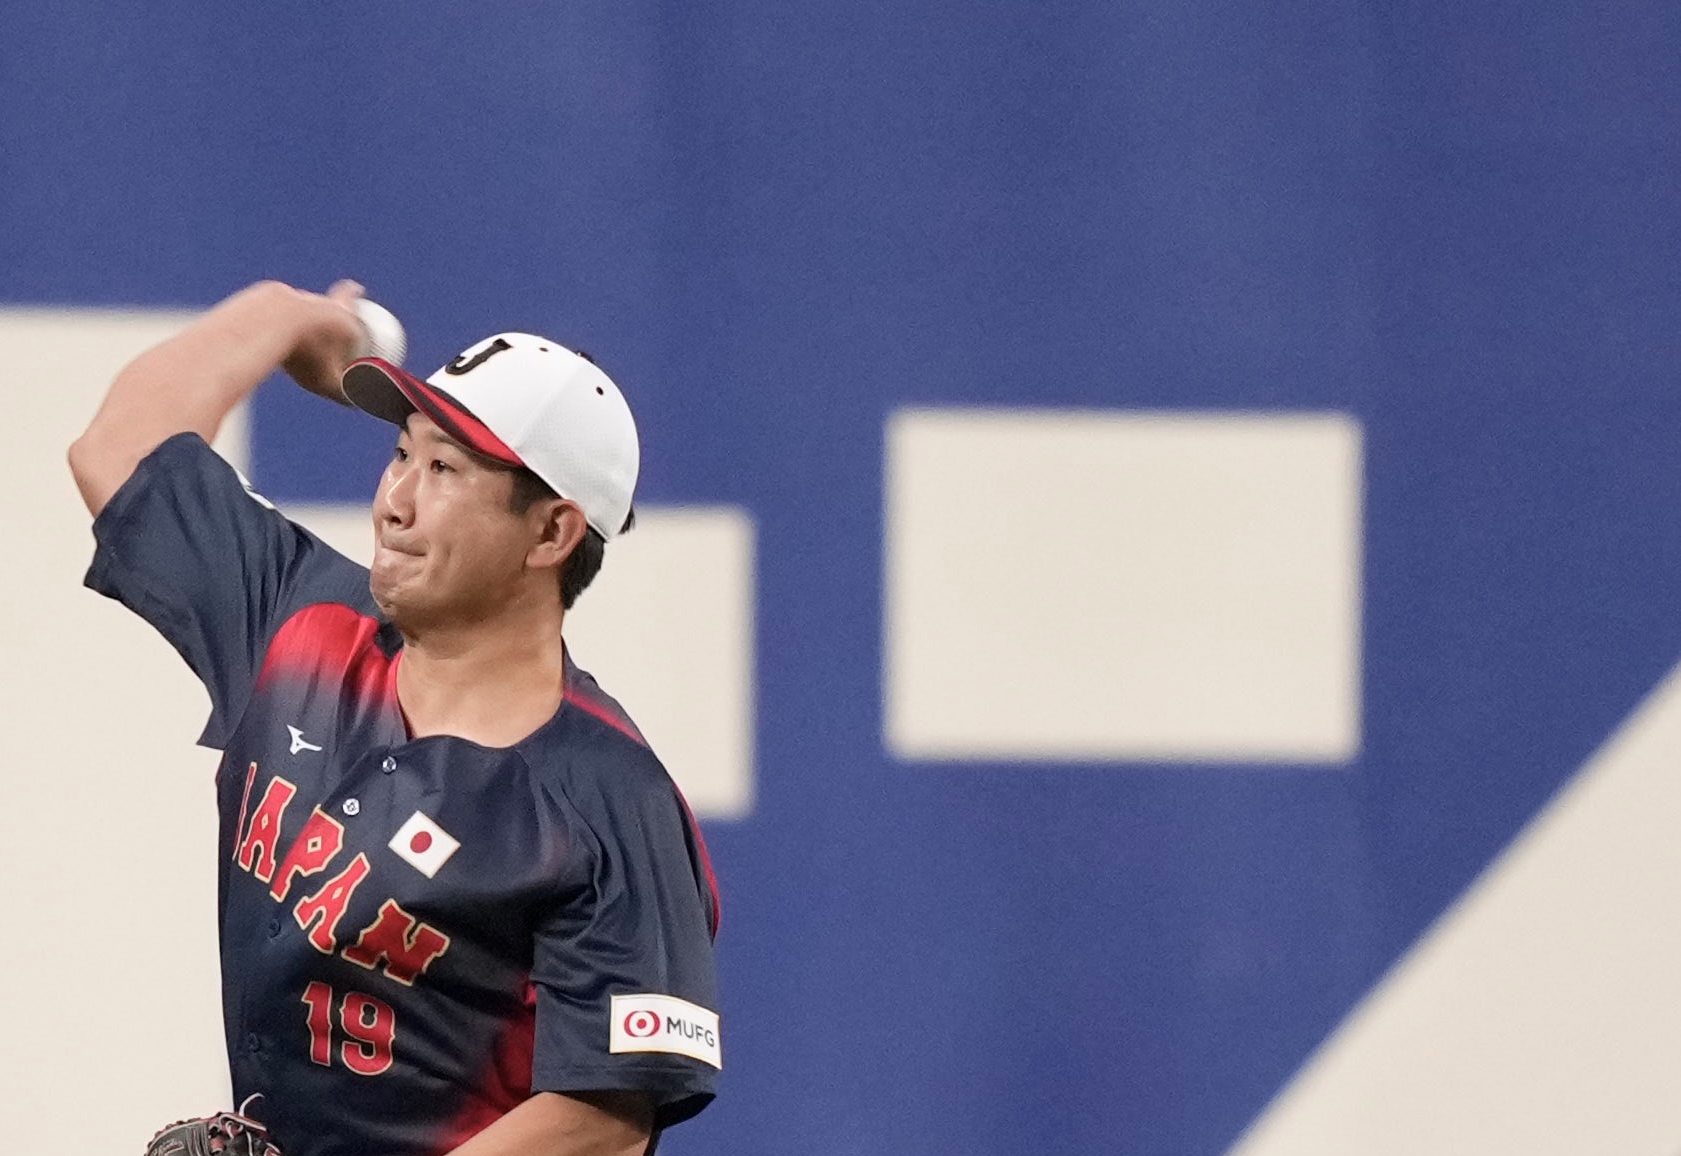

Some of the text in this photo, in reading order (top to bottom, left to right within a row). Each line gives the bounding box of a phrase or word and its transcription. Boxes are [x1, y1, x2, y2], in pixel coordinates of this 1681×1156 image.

[445, 338, 513, 376] J
[301, 980, 396, 1076] 19
[666, 1016, 715, 1048] MUFG
